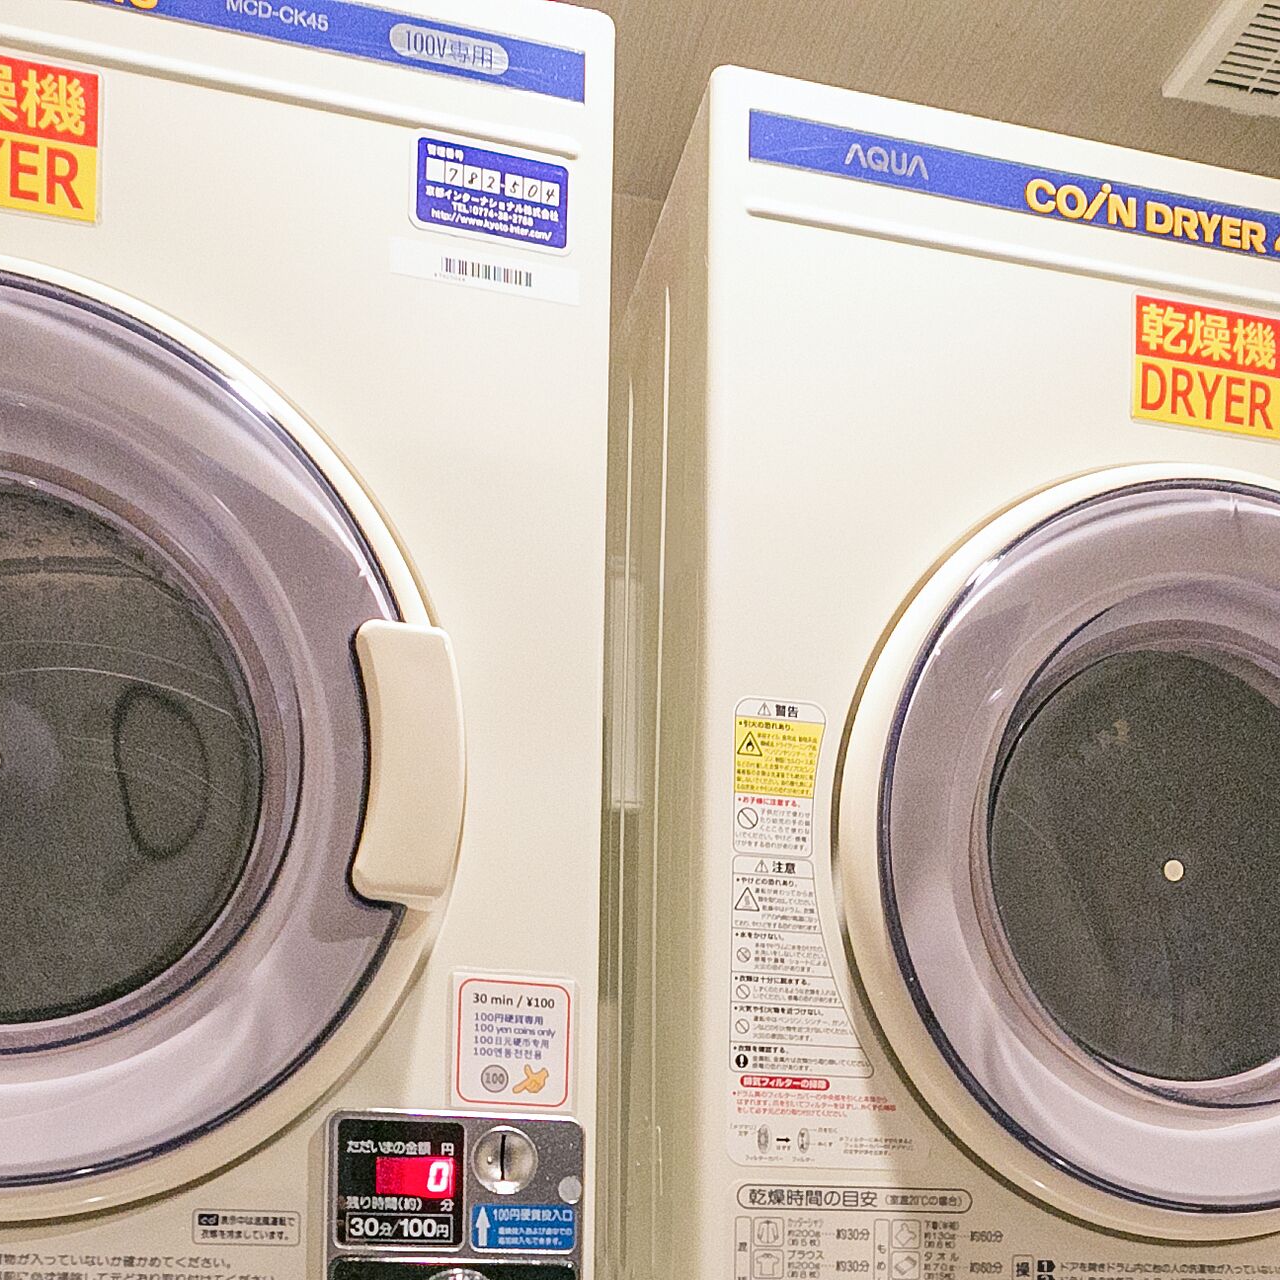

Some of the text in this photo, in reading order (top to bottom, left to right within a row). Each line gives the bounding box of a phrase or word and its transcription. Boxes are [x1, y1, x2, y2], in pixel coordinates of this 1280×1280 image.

[844, 142, 929, 181] AQUA
[1145, 202, 1267, 255] DRYER
[1141, 303, 1276, 370] 乾燥機
[1141, 361, 1273, 430] DRYER
[775, 705, 799, 718] 警告
[772, 861, 796, 874] 注意
[473, 993, 555, 1009] 30 min / ¥100
[474, 1012, 544, 1025] 100円硬貨専用
[474, 1024, 556, 1039] 100 yen coins only
[485, 1074, 505, 1085] 100
[347, 1140, 455, 1156] ただいまの金額 円
[426, 1161, 449, 1192] 0
[440, 1200, 455, 1212] 分
[749, 1189, 878, 1207] 乾燥時間の目安
[493, 1208, 573, 1222] 100円硬貨投入口
[349, 1218, 450, 1239] 30分/100円
